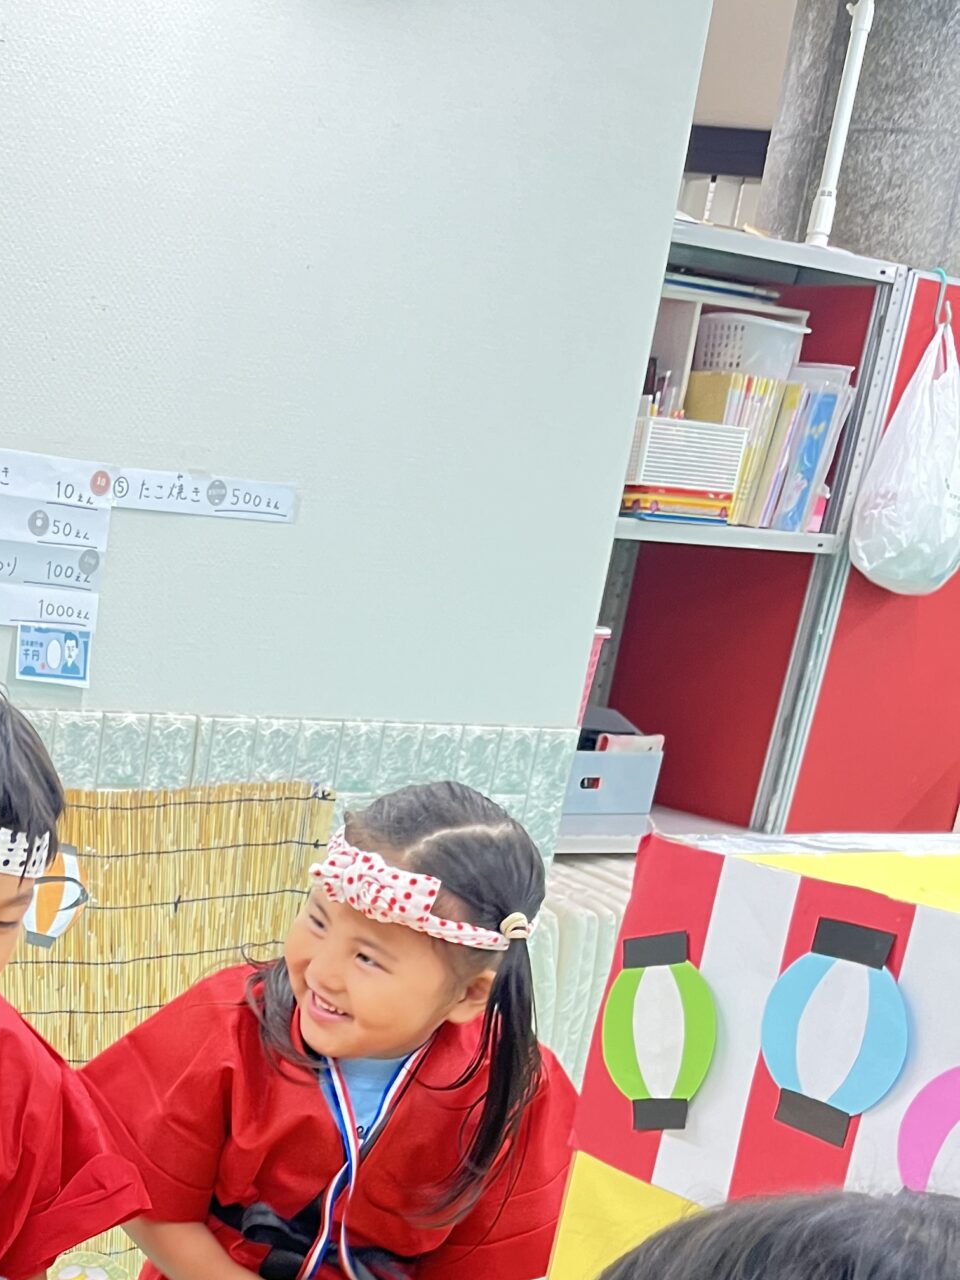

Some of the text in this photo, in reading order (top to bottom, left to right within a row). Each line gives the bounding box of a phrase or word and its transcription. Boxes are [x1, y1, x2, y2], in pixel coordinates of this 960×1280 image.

[138, 479, 201, 503] たこ焼き
[23, 648, 40, 662] 千円
